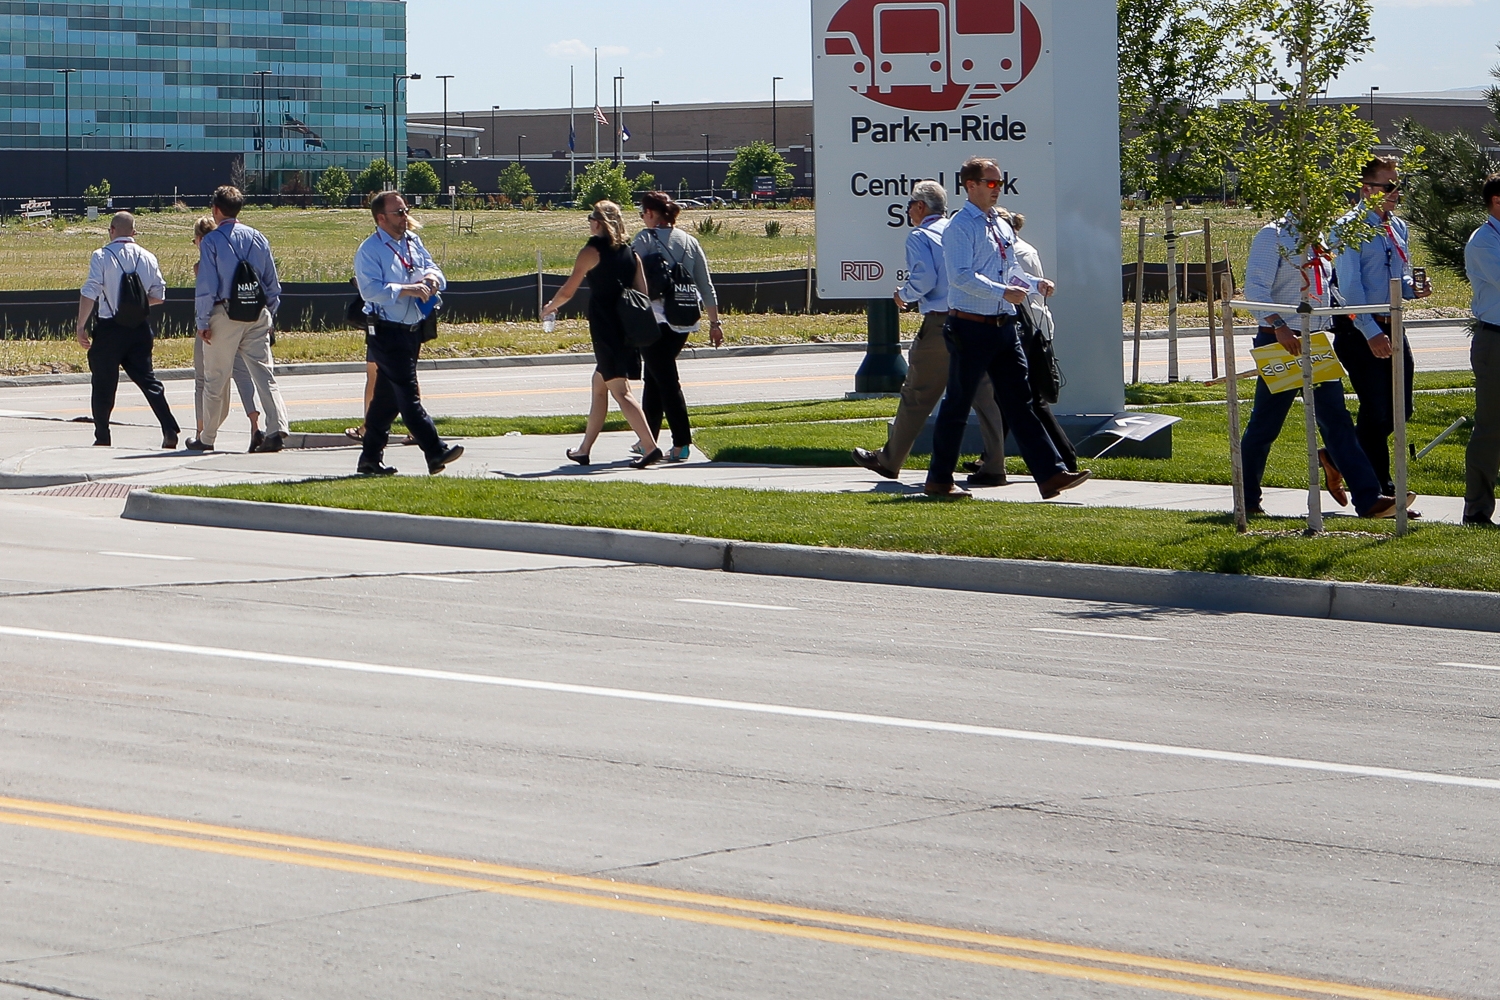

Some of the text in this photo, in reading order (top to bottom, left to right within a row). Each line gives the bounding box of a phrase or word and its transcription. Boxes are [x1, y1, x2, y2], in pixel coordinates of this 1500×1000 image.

[852, 114, 1027, 143] Park-n-Ride
[851, 171, 1019, 196] Centrl Pk
[841, 260, 884, 281] RTD
